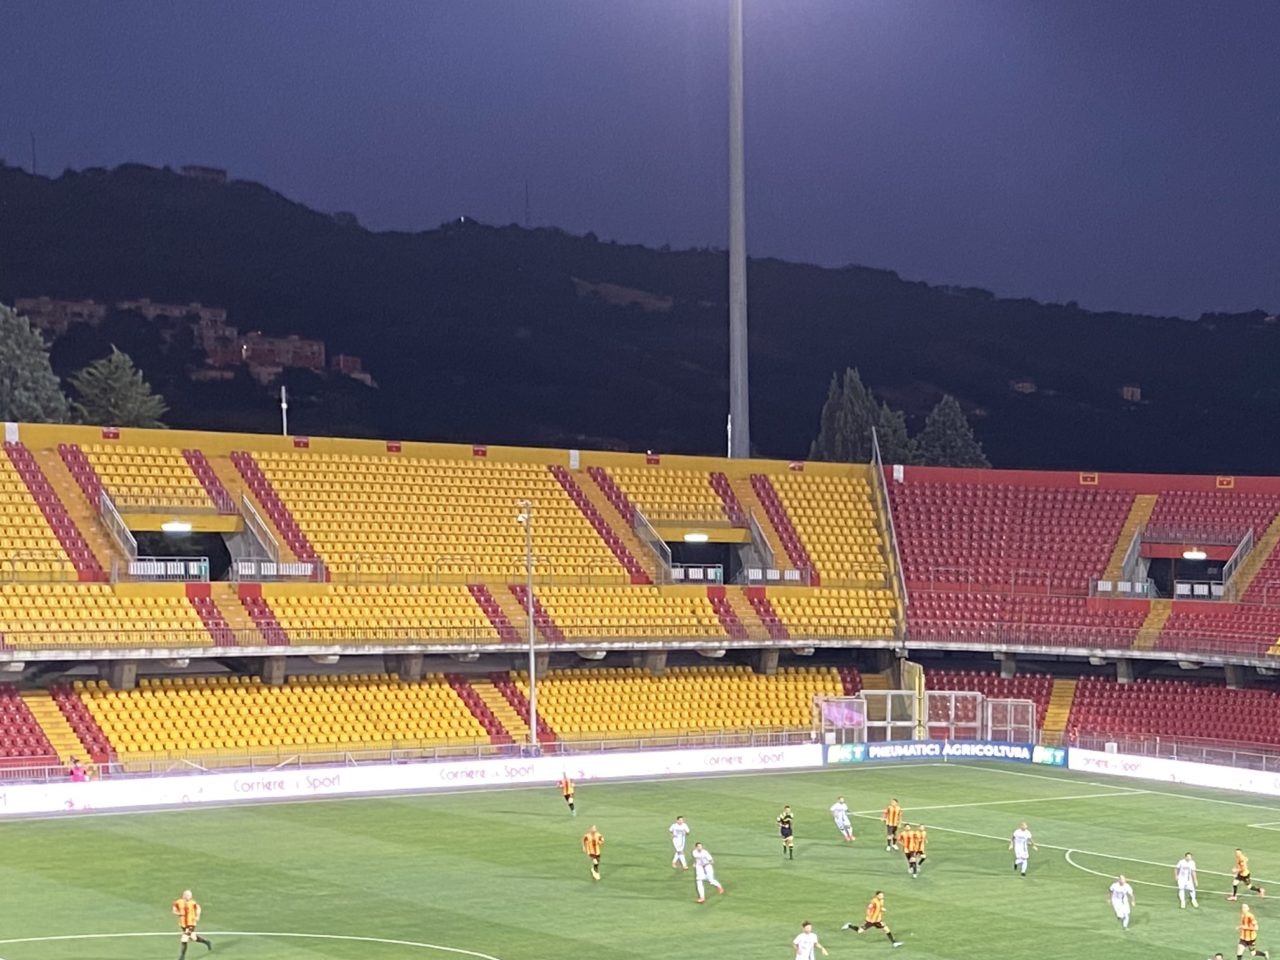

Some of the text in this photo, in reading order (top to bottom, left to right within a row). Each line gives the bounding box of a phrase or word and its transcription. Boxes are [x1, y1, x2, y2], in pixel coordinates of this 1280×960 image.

[868, 742, 1031, 760] PNEUMATICI AGRICOLTURA
[234, 778, 285, 793] Corriere
